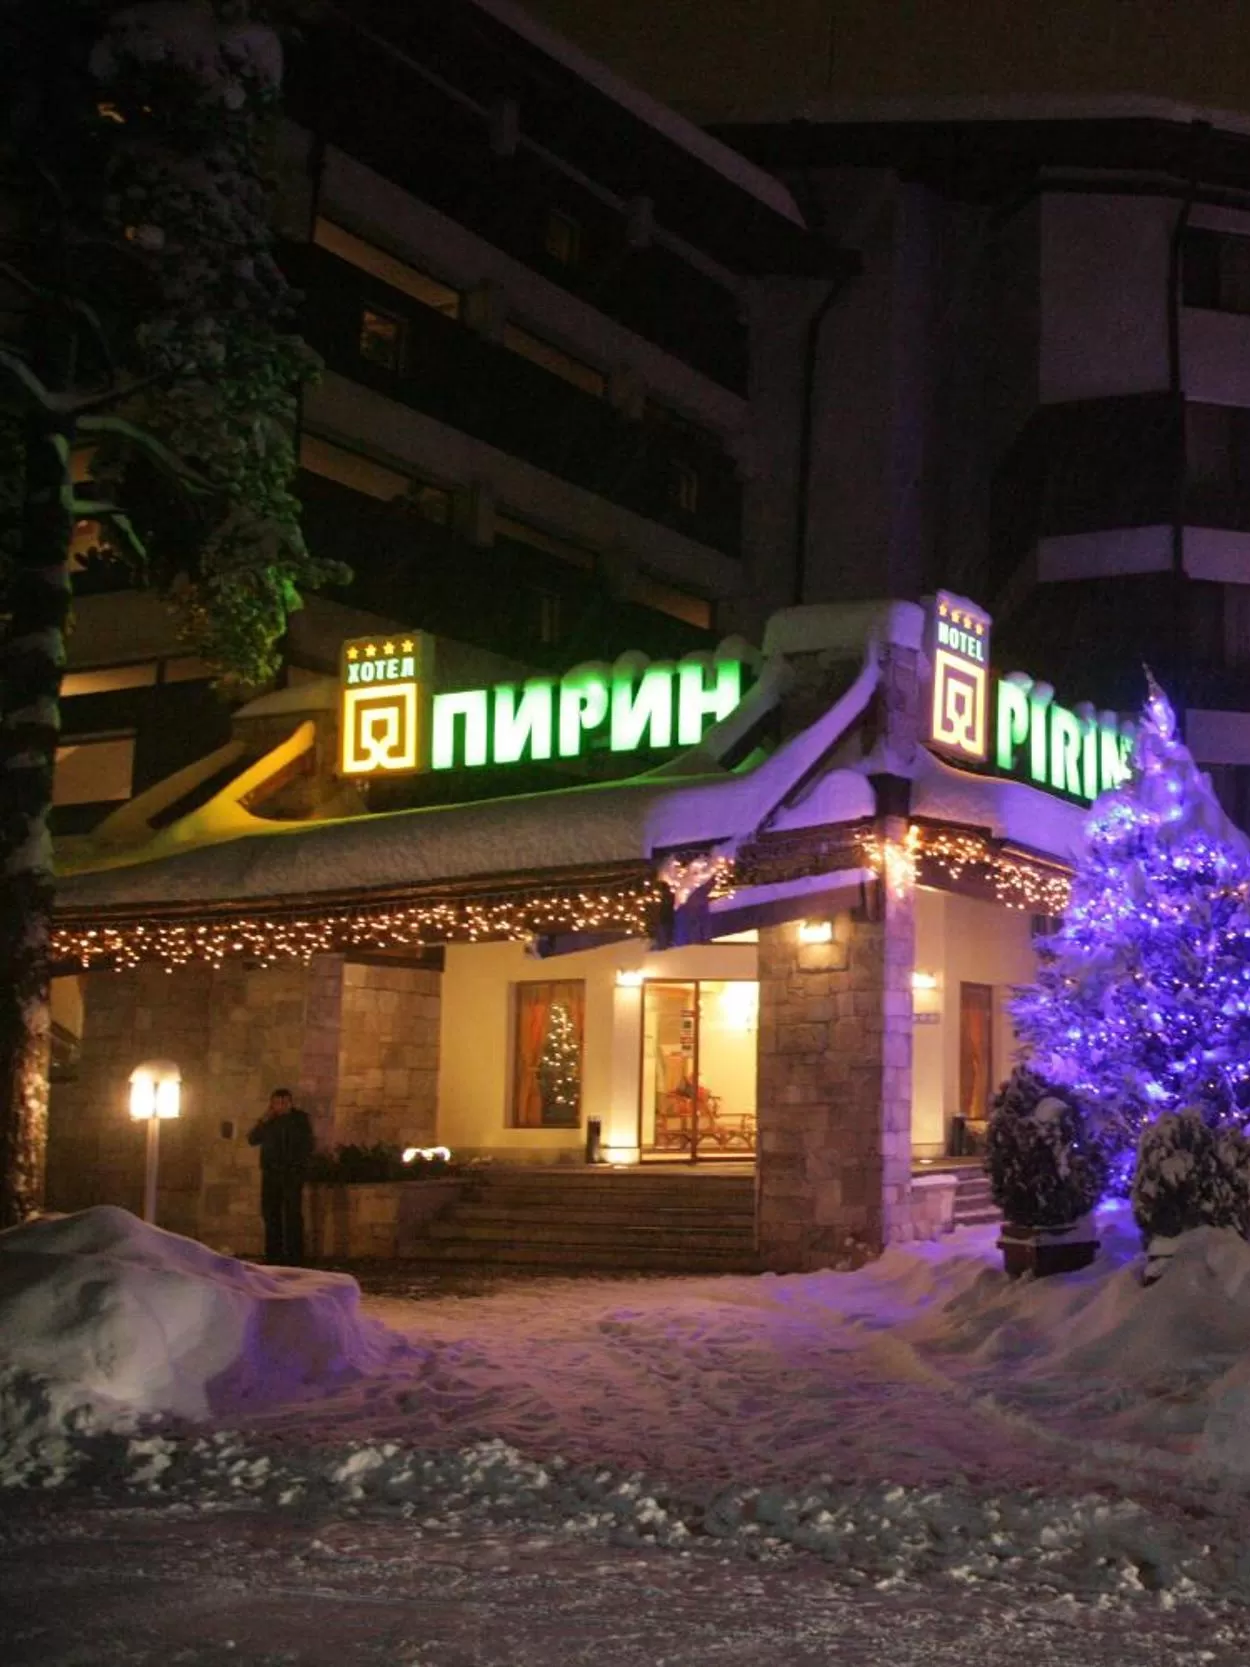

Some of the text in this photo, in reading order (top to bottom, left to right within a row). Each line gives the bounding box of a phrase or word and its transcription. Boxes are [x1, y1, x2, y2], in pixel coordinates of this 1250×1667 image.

[347, 656, 415, 684] ХОТЕЛ
[937, 621, 984, 661] HOTEL
[432, 660, 741, 769] ПИРИН
[997, 679, 1134, 800] PIRIN
